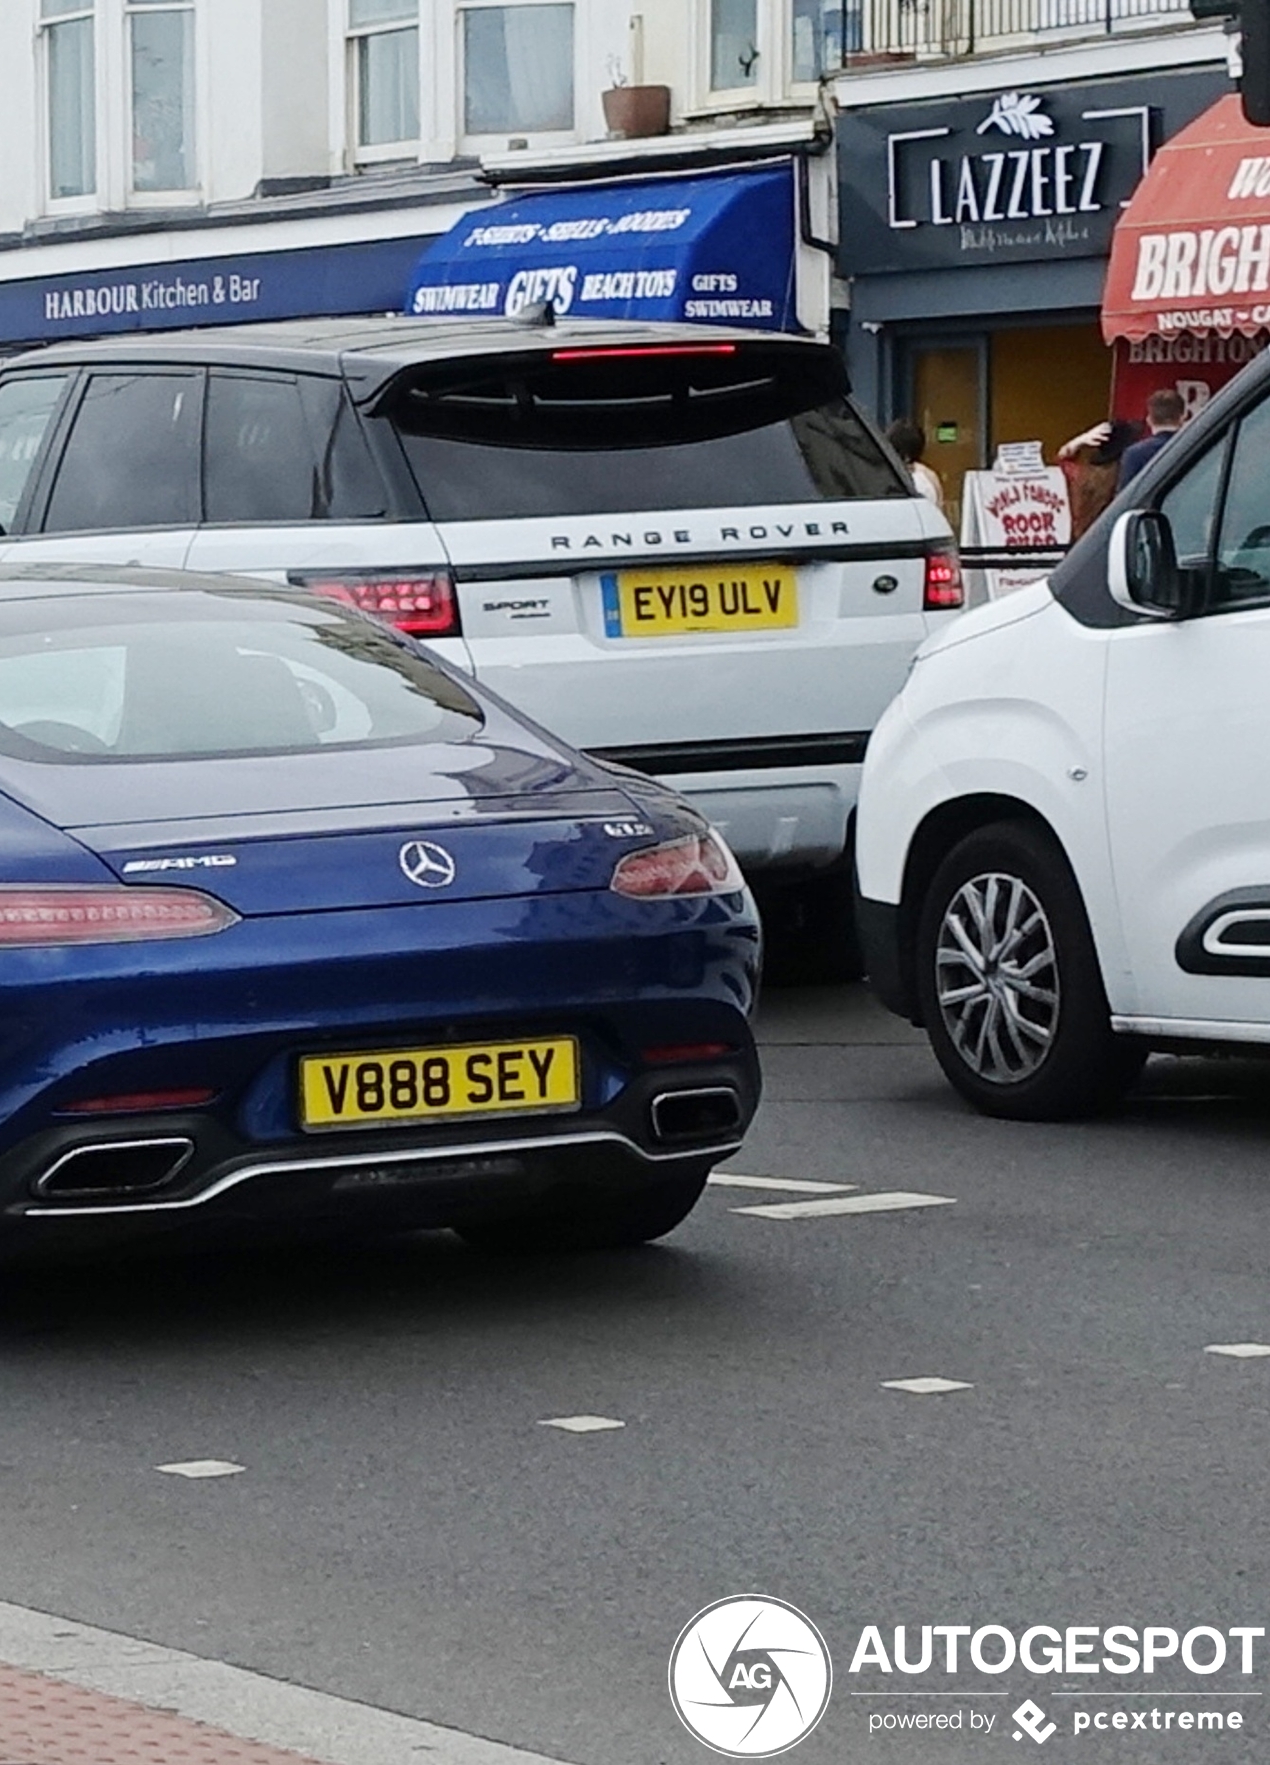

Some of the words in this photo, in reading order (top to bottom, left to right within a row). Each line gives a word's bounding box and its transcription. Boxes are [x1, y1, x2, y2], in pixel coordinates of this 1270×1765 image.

[931, 142, 1103, 225] LAZZEEZ
[45, 284, 139, 319] HARBOUR
[141, 277, 209, 309] Kitchen
[213, 276, 226, 304] &
[230, 274, 261, 301] Bar
[412, 283, 500, 313] SWIMWEAR
[505, 266, 578, 316] GIFTS
[580, 272, 637, 301] BEACH
[635, 269, 678, 296] TOYS
[692, 274, 738, 292] GIFTS
[684, 299, 773, 317] SWIMWEAR
[1157, 308, 1233, 331] NOUGAT
[551, 530, 692, 549] RANGE
[720, 521, 850, 541] ROVER
[634, 584, 709, 620] EY19
[719, 579, 782, 615] ULV
[160, 854, 237, 870] AMG
[323, 1057, 451, 1115] V888
[465, 1048, 555, 1104] SEY
